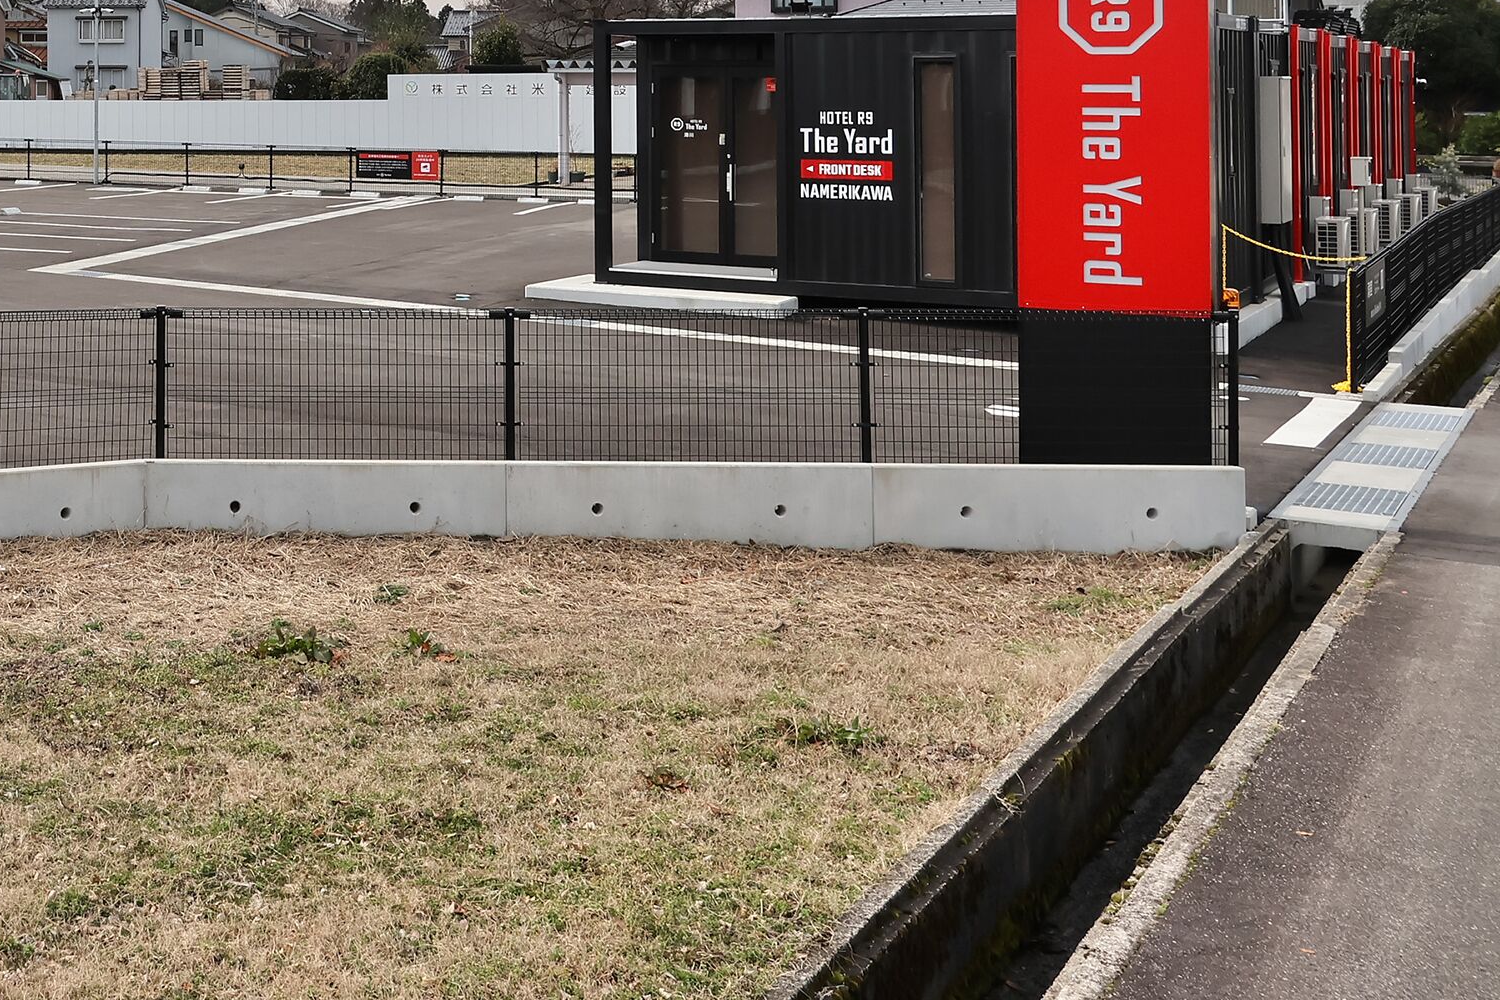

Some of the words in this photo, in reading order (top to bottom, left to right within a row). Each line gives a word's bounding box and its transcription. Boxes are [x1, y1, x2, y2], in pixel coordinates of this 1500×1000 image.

[819, 111, 853, 124] HOTEL
[857, 111, 873, 125] R9
[1081, 75, 1141, 161] The
[800, 127, 838, 153] The
[843, 128, 893, 154] Yard
[818, 163, 852, 175] FRONT
[853, 164, 882, 176] DESK
[800, 183, 893, 201] NAMERIKAWA
[1082, 176, 1143, 287] Yard
